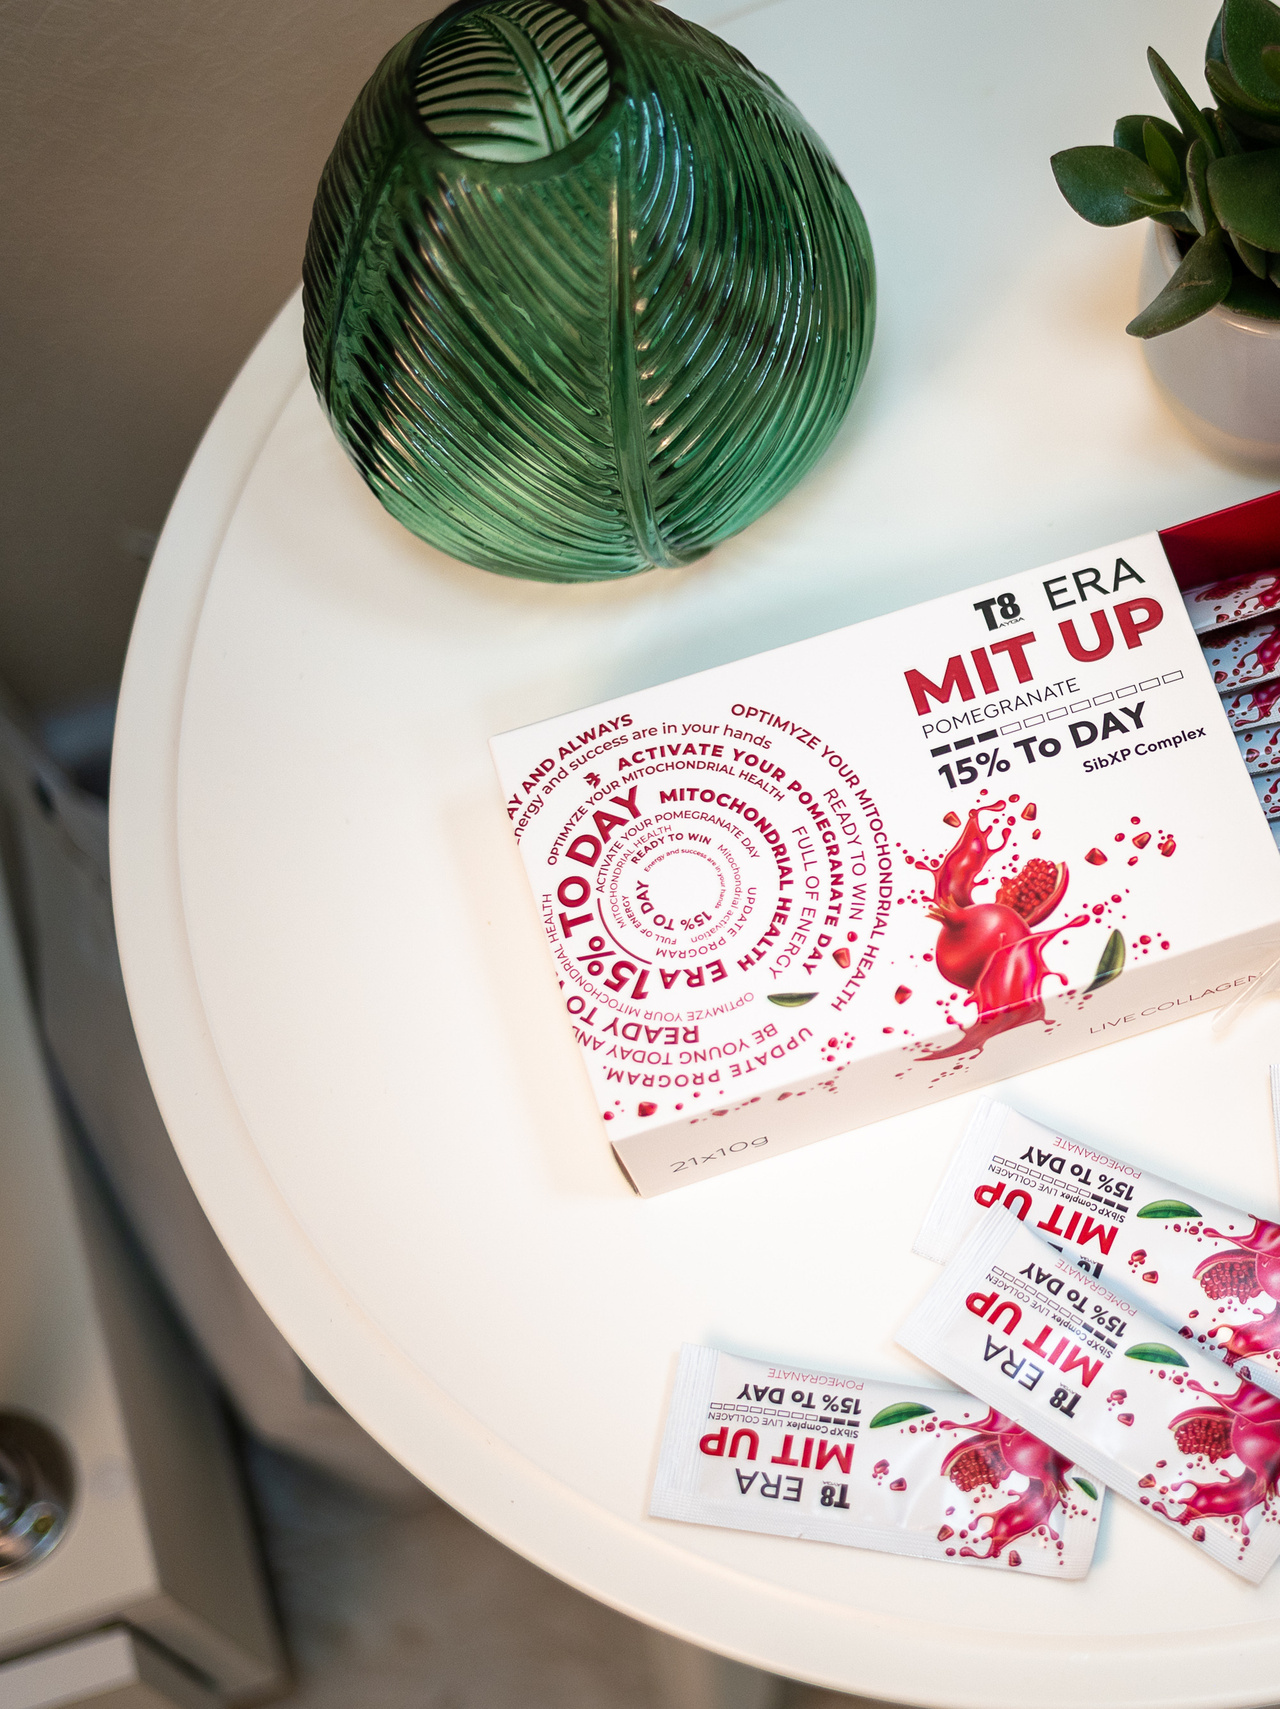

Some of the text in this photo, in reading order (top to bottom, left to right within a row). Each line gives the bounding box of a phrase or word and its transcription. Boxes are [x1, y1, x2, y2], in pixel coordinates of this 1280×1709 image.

[1042, 557, 1146, 611] ERA
[904, 597, 1164, 716] MIT UP
[922, 678, 1080, 739] POMEGRANATE
[522, 758, 555, 795] AND
[558, 714, 633, 760] ALWAYS
[542, 767, 569, 794] and
[569, 735, 628, 771] success
[632, 726, 658, 741] are
[662, 722, 677, 734] in
[681, 724, 720, 735] your
[723, 724, 772, 749] hands
[938, 701, 1146, 789] 15% To DAY
[1083, 727, 1206, 773] SibXP Complex
[547, 761, 785, 865] OPTIMYZE YOUR MITOCHONDRIAL HEALTH
[596, 810, 760, 893] ACTIVATE YOUR POMEGRANATE DAY
[619, 743, 844, 975] ACTIVATE YOUR POMEGRANATE DAY
[631, 833, 711, 864] READY TO WIN
[731, 704, 893, 1011] OPTIMYZE YOUR MITOCHONDRIAL HEALTH
[823, 788, 867, 920] READY TO WIN
[558, 785, 650, 1000] 15% TO DAY
[636, 880, 712, 931] 15% TO DAY
[659, 788, 794, 989] MITOCHONDRIAL HEALTH ERA
[769, 826, 820, 979] FULL OF ENERGY
[542, 894, 559, 943] HEALTH
[656, 887, 757, 959] UPDATE PROGRAM
[554, 944, 641, 1017] MITOCHONDRIAL
[687, 993, 754, 1021] OPTIMYZE
[566, 996, 699, 1045] READY TO
[644, 1010, 682, 1022] YOUR
[752, 1023, 778, 1044] BE
[1090, 1014, 1136, 1034] LIVE
[606, 1044, 673, 1065] TODAY
[679, 1039, 750, 1064] YOUNG
[729, 1028, 813, 1078] UPDATE
[670, 1136, 768, 1173] 21x10g
[1020, 1146, 1134, 1201] 15% To DAY
[1053, 1136, 1142, 1179] POMEGRANATE
[974, 1181, 1119, 1255] MIT UP
[988, 1164, 1126, 1223] SibXP Complex LIVE COLLAGEN
[1019, 1263, 1065, 1296] DAY
[1055, 1258, 1138, 1317] POMEGRANATE
[1067, 1289, 1088, 1313] To
[965, 1291, 1104, 1388] MIT UP
[985, 1273, 1113, 1358] SibXP Complex LIVE COLLAGEN
[1091, 1305, 1127, 1338] 15%
[767, 1368, 864, 1390] POMEGRANATE
[984, 1334, 1044, 1391] ERA
[708, 1412, 859, 1438] SibXP Complex LIVE COLLAGEN
[736, 1384, 862, 1415] 15% To DAY
[699, 1426, 855, 1474] MIT UP
[735, 1468, 804, 1502] ERA
